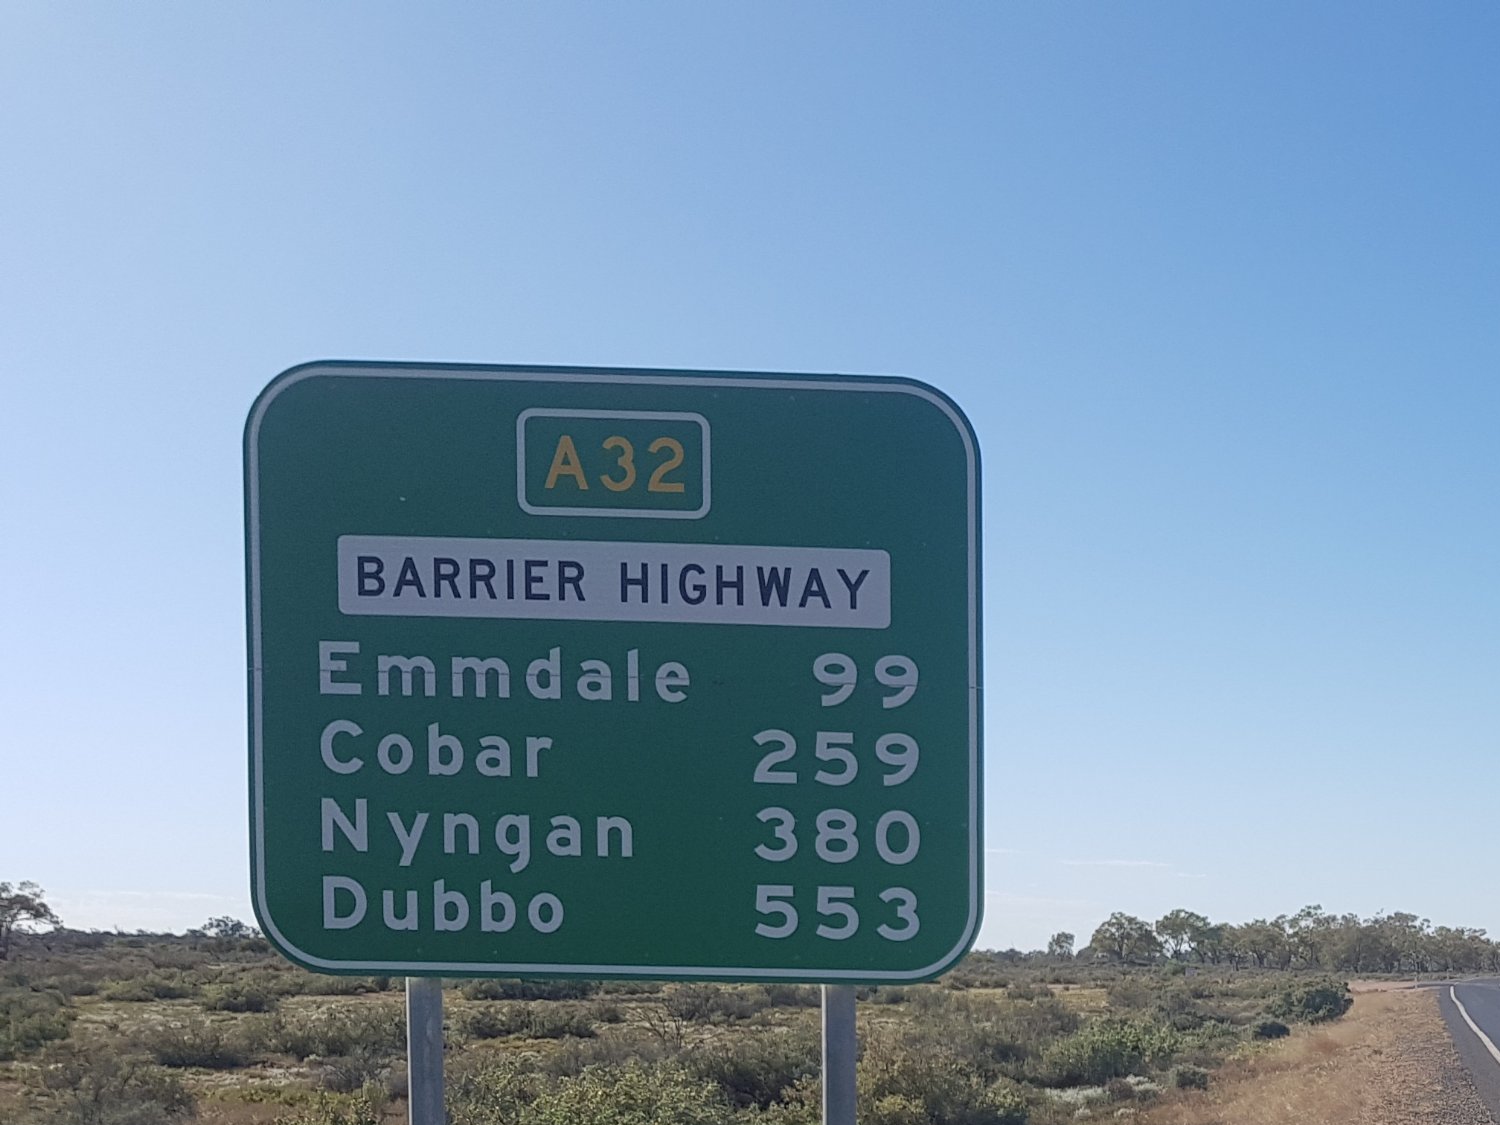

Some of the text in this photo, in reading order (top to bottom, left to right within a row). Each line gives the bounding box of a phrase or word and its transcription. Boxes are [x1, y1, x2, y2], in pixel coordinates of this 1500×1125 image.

[545, 435, 684, 492] A32
[357, 556, 869, 609] BARRIER HIGHWAY
[319, 641, 918, 708] Emmdale 99
[321, 720, 919, 786] Cobar 259
[322, 798, 920, 873] Nyngan 380
[323, 876, 919, 941] Dubbo 553
